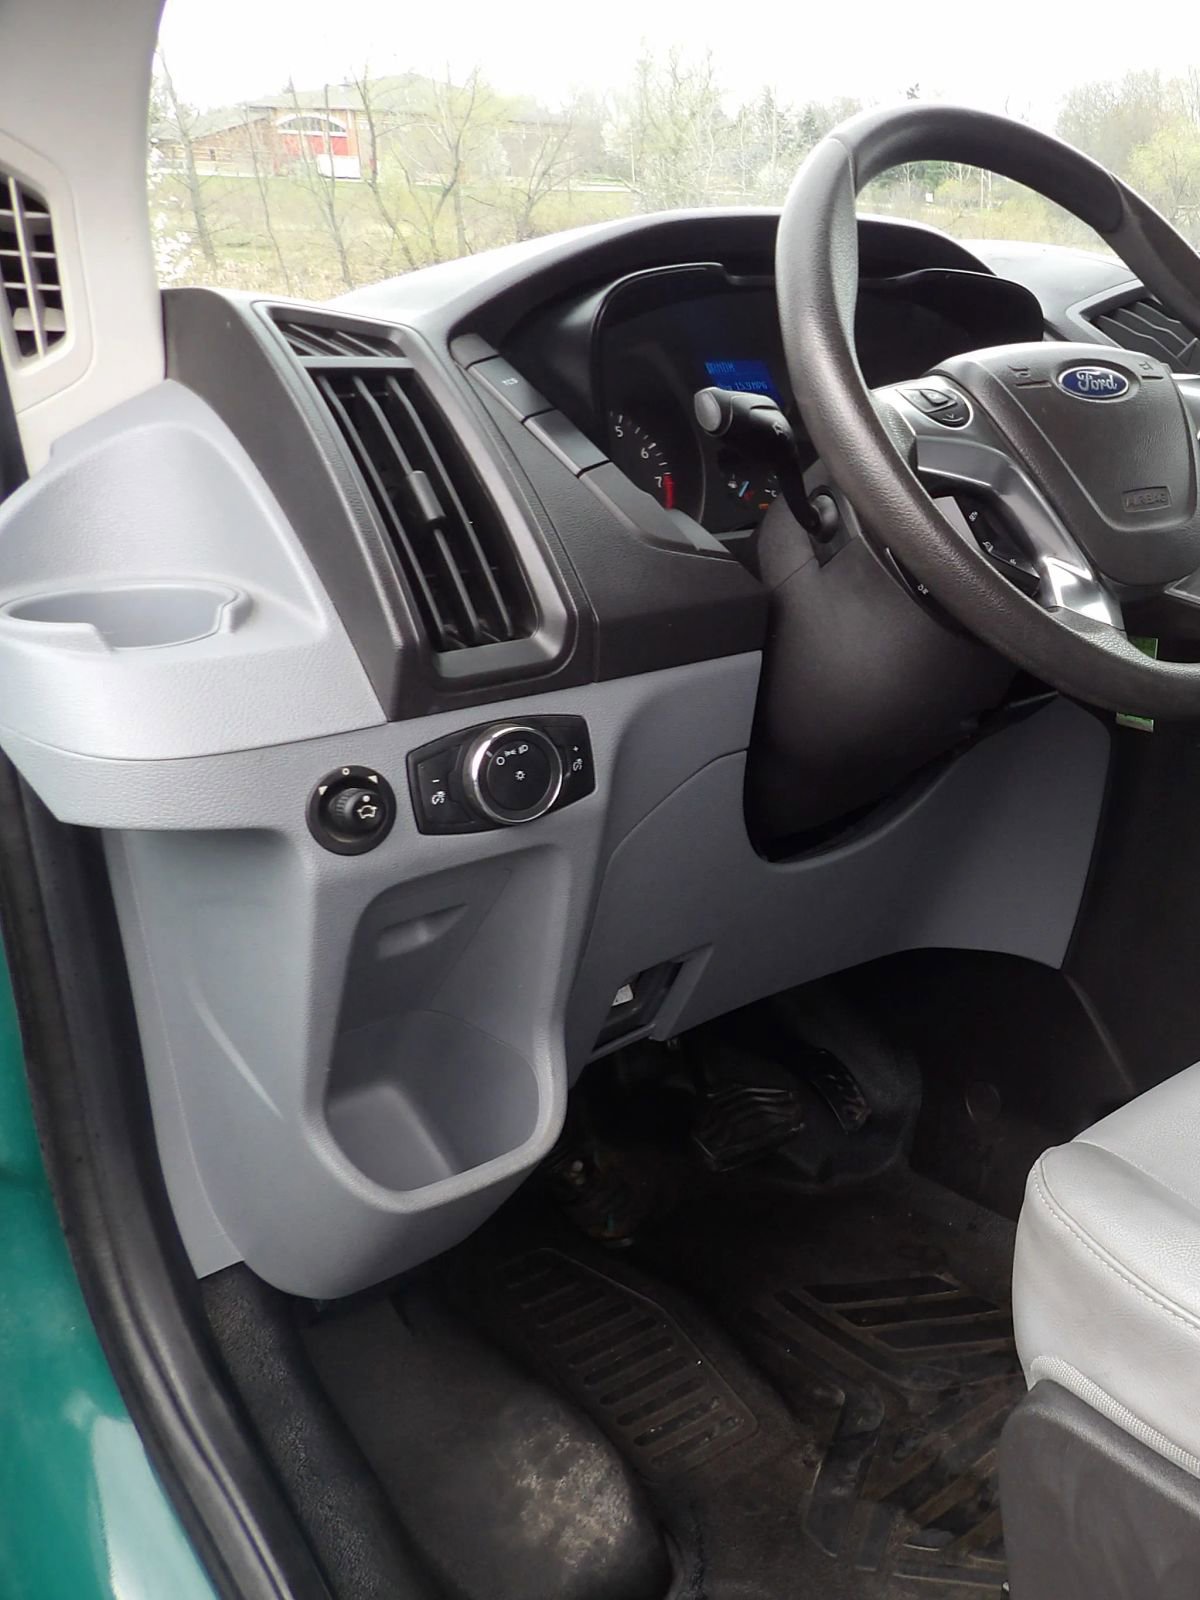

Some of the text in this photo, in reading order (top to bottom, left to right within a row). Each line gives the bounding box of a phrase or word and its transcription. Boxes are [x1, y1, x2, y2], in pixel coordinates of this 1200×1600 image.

[1076, 370, 1117, 391] Ford
[615, 425, 624, 437] 5
[641, 447, 649, 459] 6
[654, 476, 662, 488] 7
